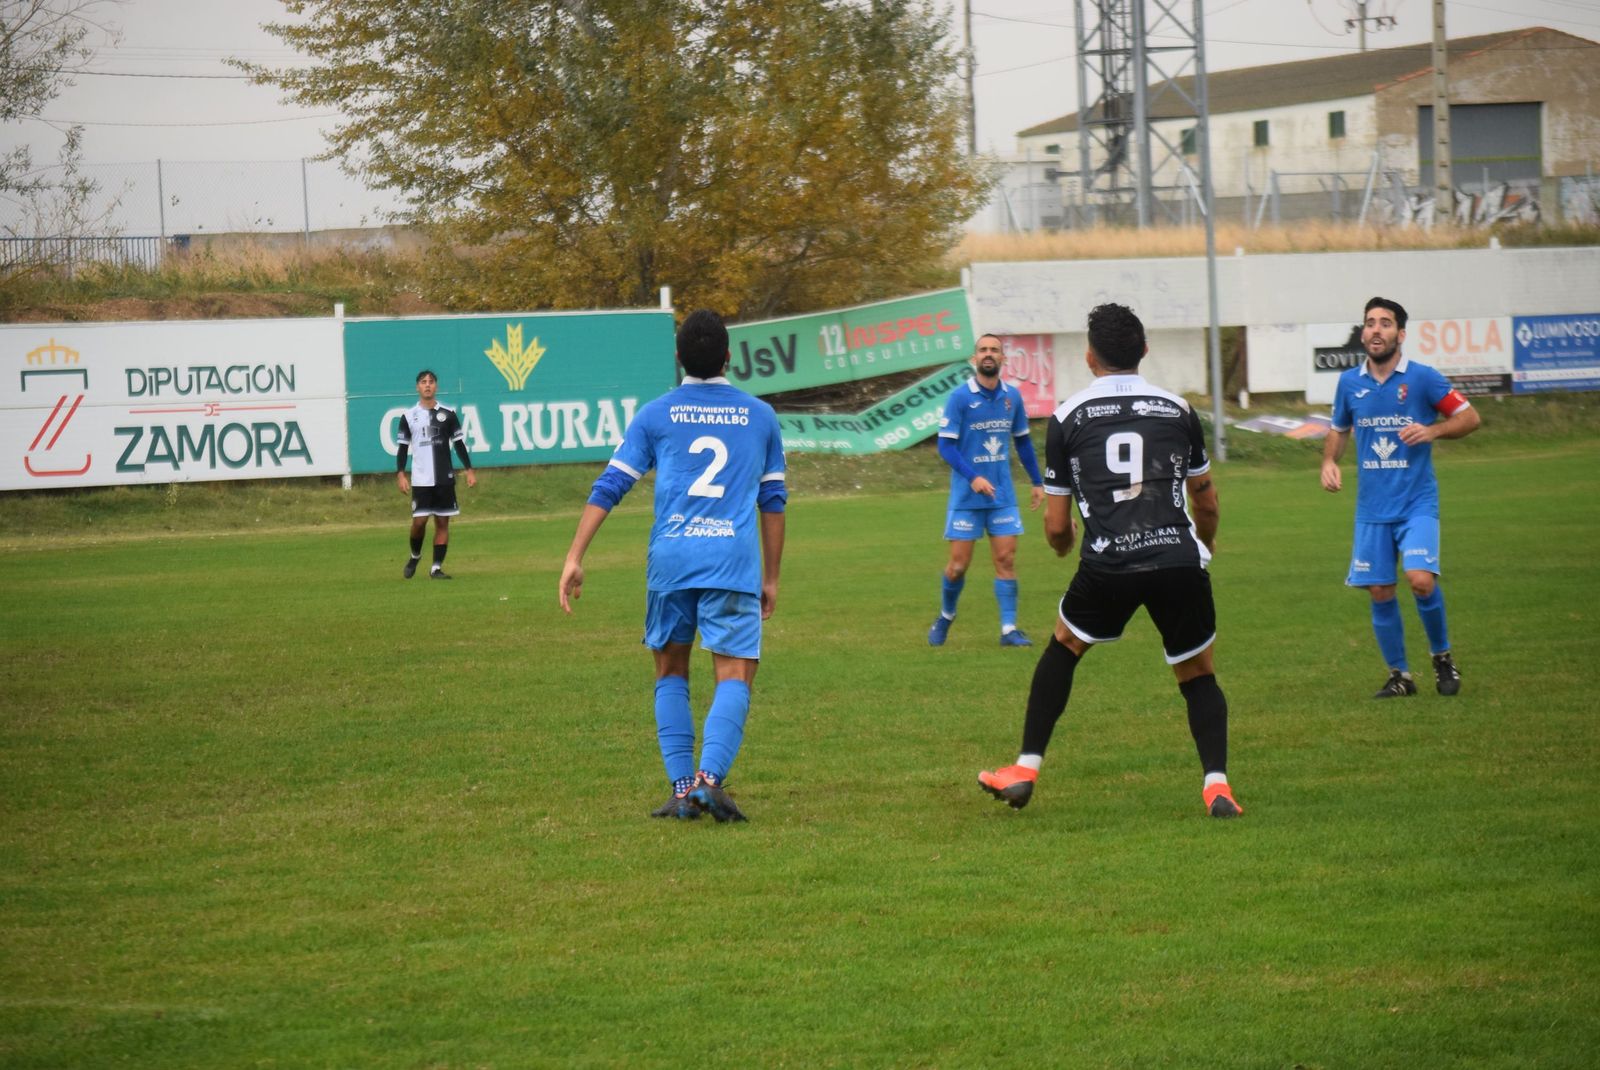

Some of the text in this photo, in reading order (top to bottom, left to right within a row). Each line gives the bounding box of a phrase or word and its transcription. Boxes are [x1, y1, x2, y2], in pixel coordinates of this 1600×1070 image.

[1418, 319, 1504, 355] SOLA
[732, 334, 797, 381] JsV
[824, 336, 963, 369] consulting
[669, 405, 749, 415] AYUNTAMIENTO DE
[670, 413, 749, 426] VILLARALBO
[1362, 414, 1413, 427] euronics
[114, 421, 314, 474] ZAMORA
[873, 426, 911, 449] 980
[687, 435, 729, 499] 2
[1105, 432, 1144, 503] 9
[683, 527, 735, 538] ZAMORA
[1114, 526, 1180, 545] CAJA RURAL
